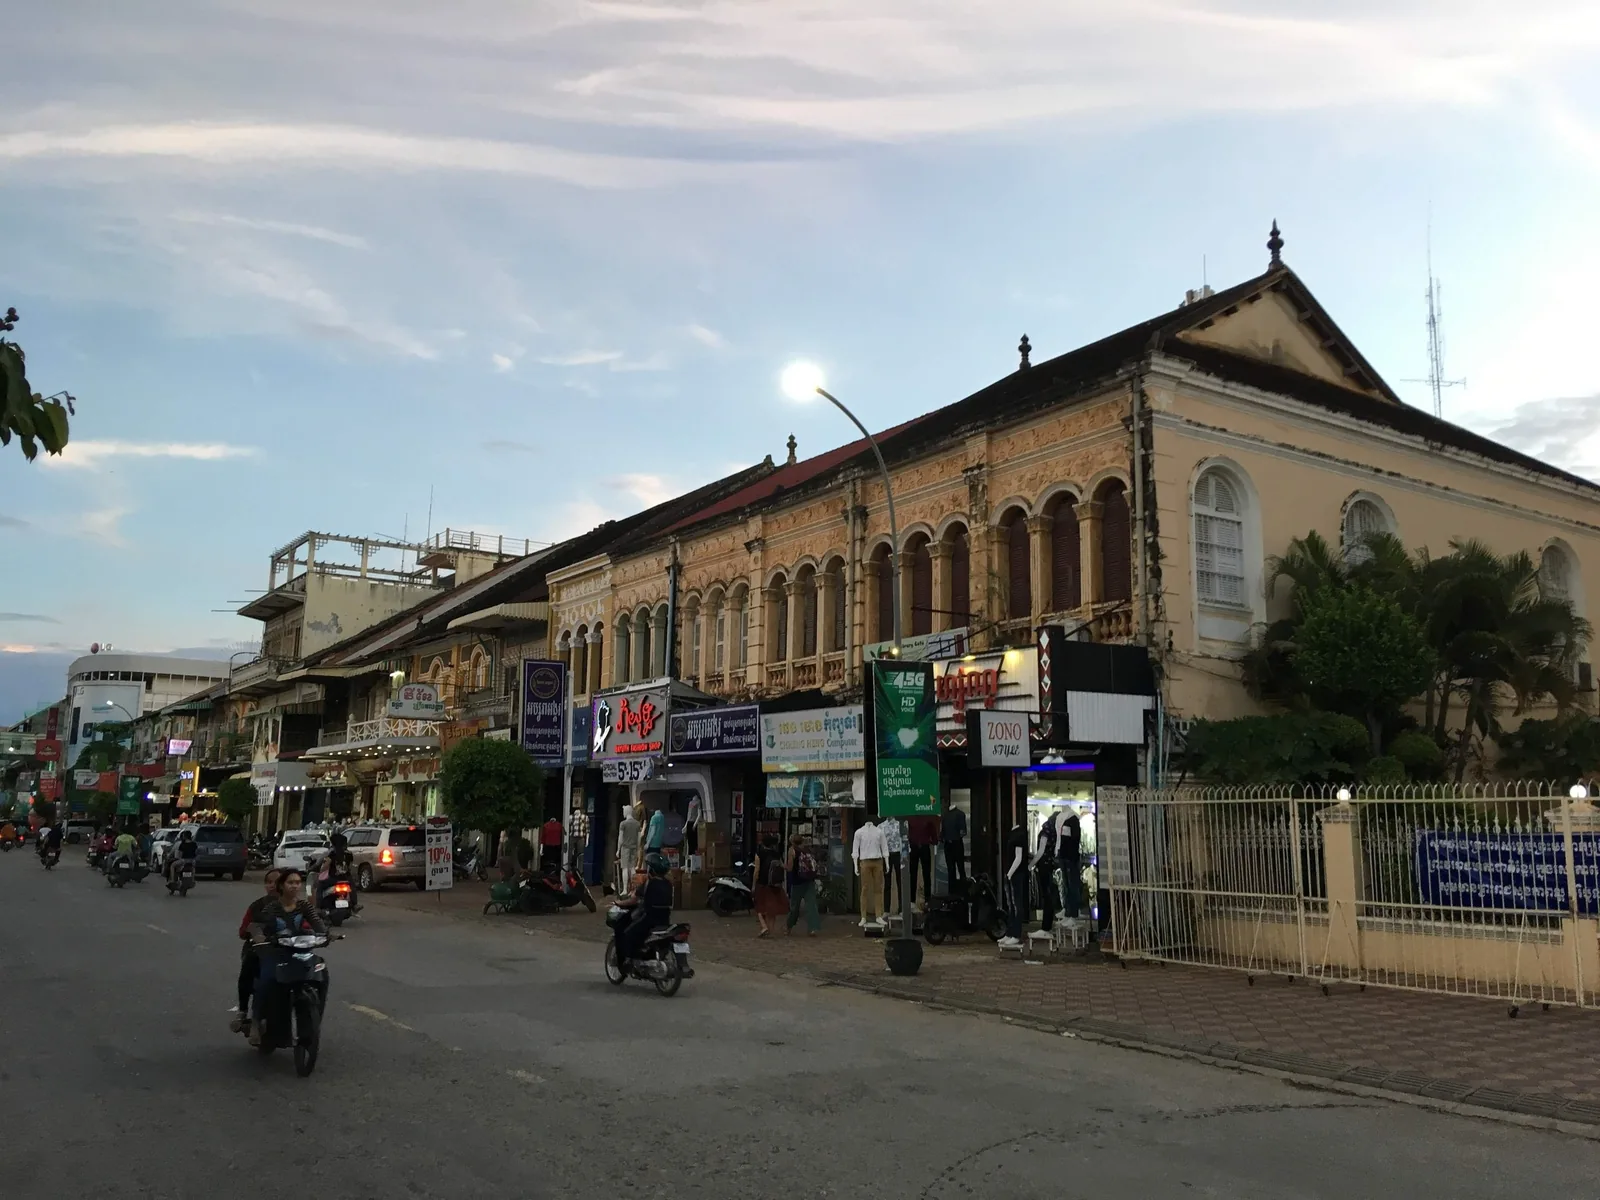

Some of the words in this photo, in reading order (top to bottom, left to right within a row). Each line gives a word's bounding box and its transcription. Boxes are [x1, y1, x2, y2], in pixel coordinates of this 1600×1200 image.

[893, 671, 925, 689] 4.5G
[901, 696, 916, 707] HD
[987, 722, 1022, 741] ZONO
[826, 737, 858, 751] Computer
[992, 744, 1020, 758] STYLE
[915, 803, 934, 812] Smart
[427, 845, 451, 865] 10%
